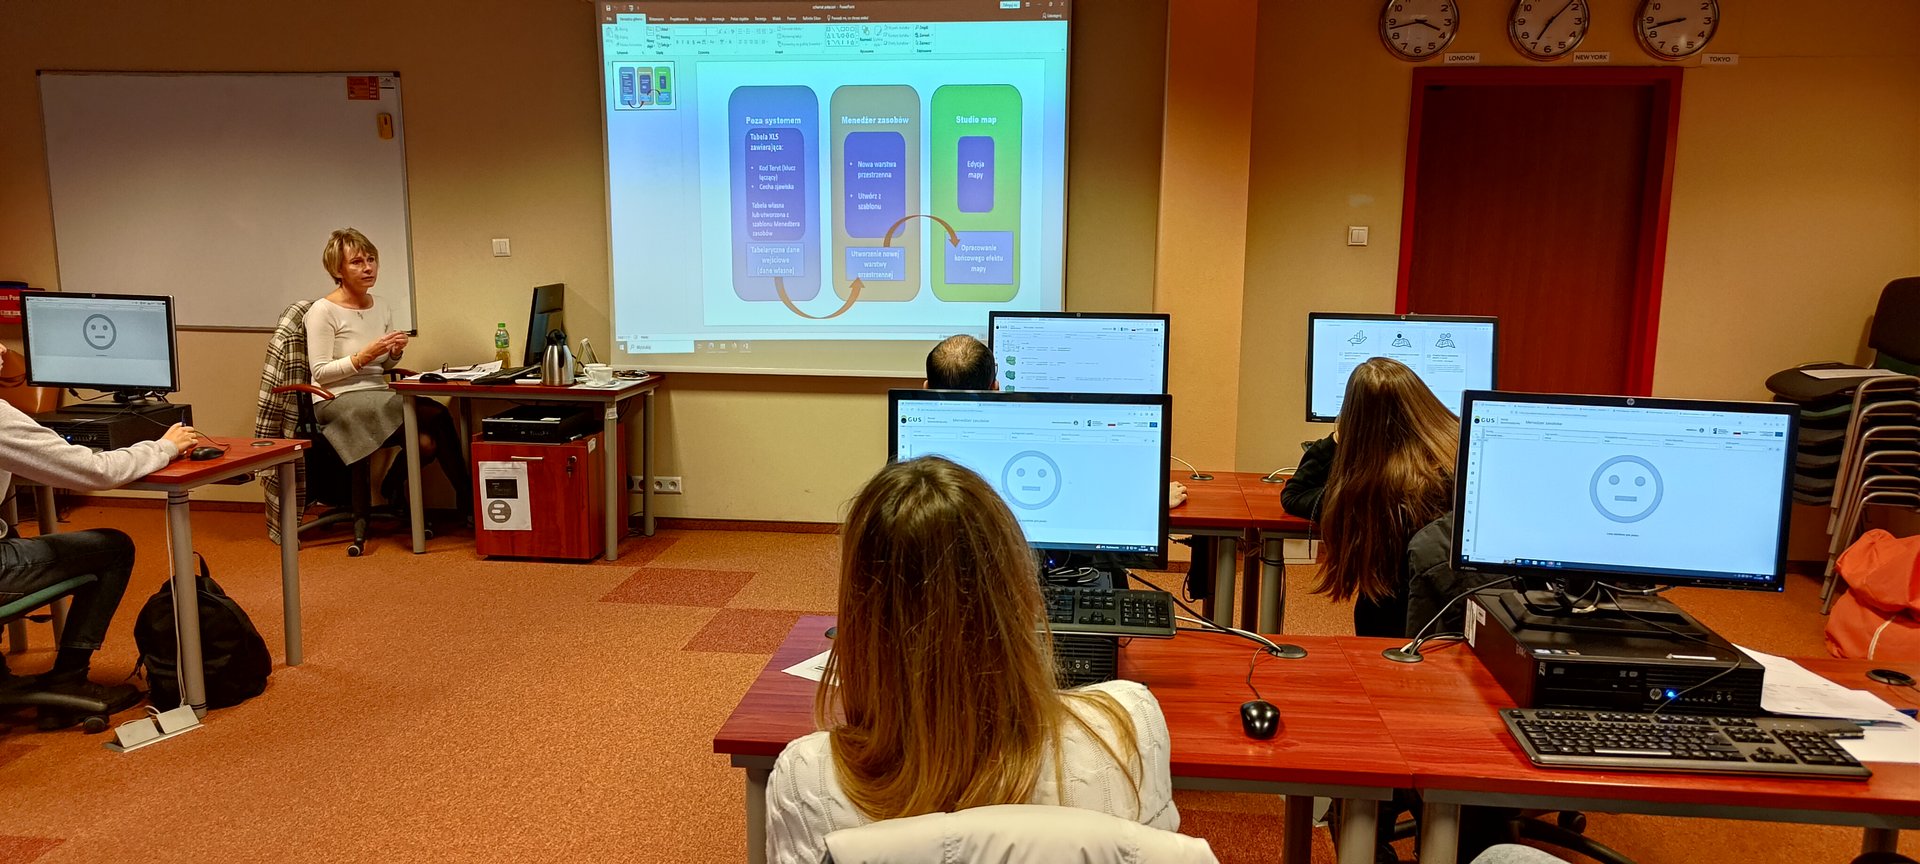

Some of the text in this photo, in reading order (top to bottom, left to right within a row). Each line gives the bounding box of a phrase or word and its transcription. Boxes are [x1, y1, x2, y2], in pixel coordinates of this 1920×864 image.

[1394, 4, 1402, 12] 10
[1440, 4, 1448, 12] 2
[1523, 4, 1532, 12] 10
[1444, 18, 1452, 26] 3
[746, 116, 802, 126] Poza systemem
[841, 116, 909, 124] Menedżer zasobów
[956, 115, 997, 125] Studio map
[967, 160, 985, 168] Edycja
[858, 171, 892, 179] przestrzenna
[968, 172, 984, 180] mapy
[858, 192, 878, 200] Utwórz
[751, 246, 785, 254] Tabelaryczne
[960, 244, 997, 253] Opracowanie
[882, 250, 900, 259] nowej
[954, 254, 985, 262] końcowego
[864, 261, 887, 269] warstwy
[970, 265, 987, 274] mapy
